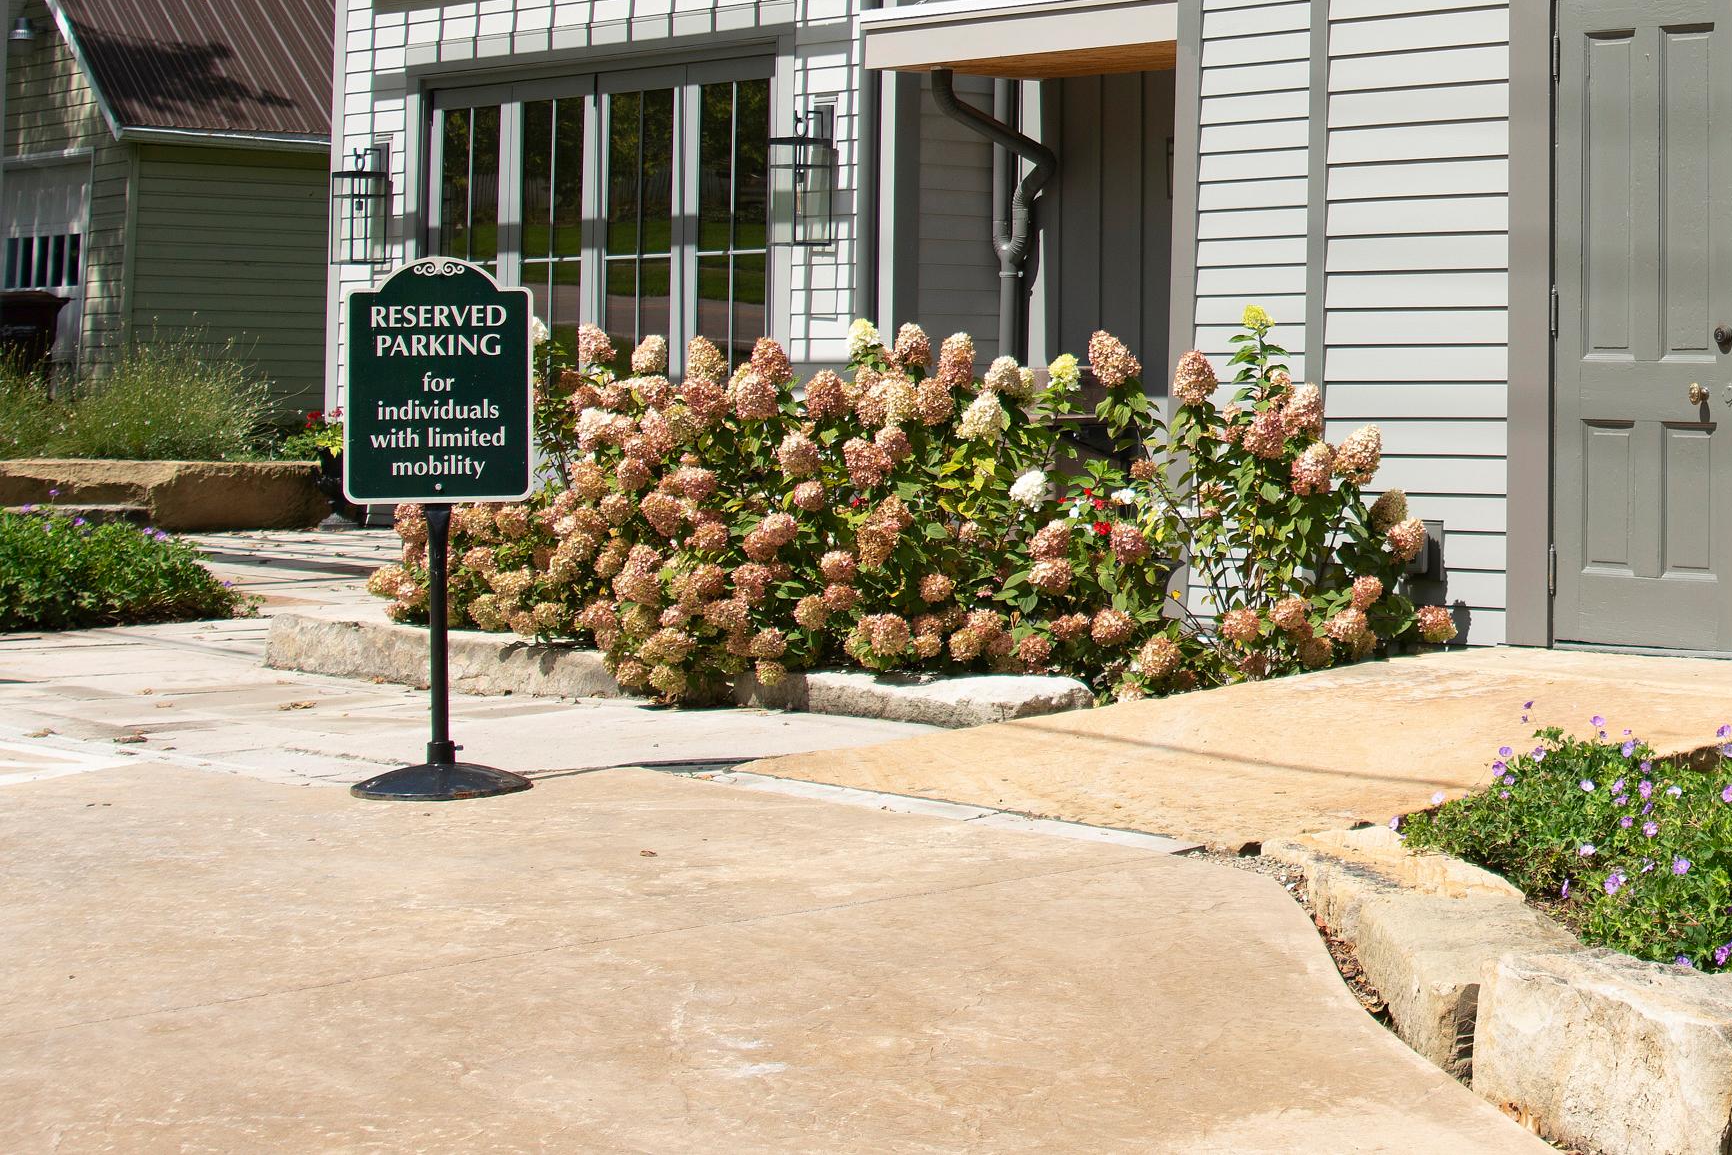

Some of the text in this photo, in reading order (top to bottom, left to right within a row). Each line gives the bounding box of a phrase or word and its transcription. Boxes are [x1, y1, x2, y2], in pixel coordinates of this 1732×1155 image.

[370, 305, 507, 328] RESERVED
[376, 334, 501, 357] PARKING
[422, 372, 455, 392] for
[377, 399, 500, 420] individuals
[370, 426, 506, 448] with limited
[392, 455, 486, 479] mobility
